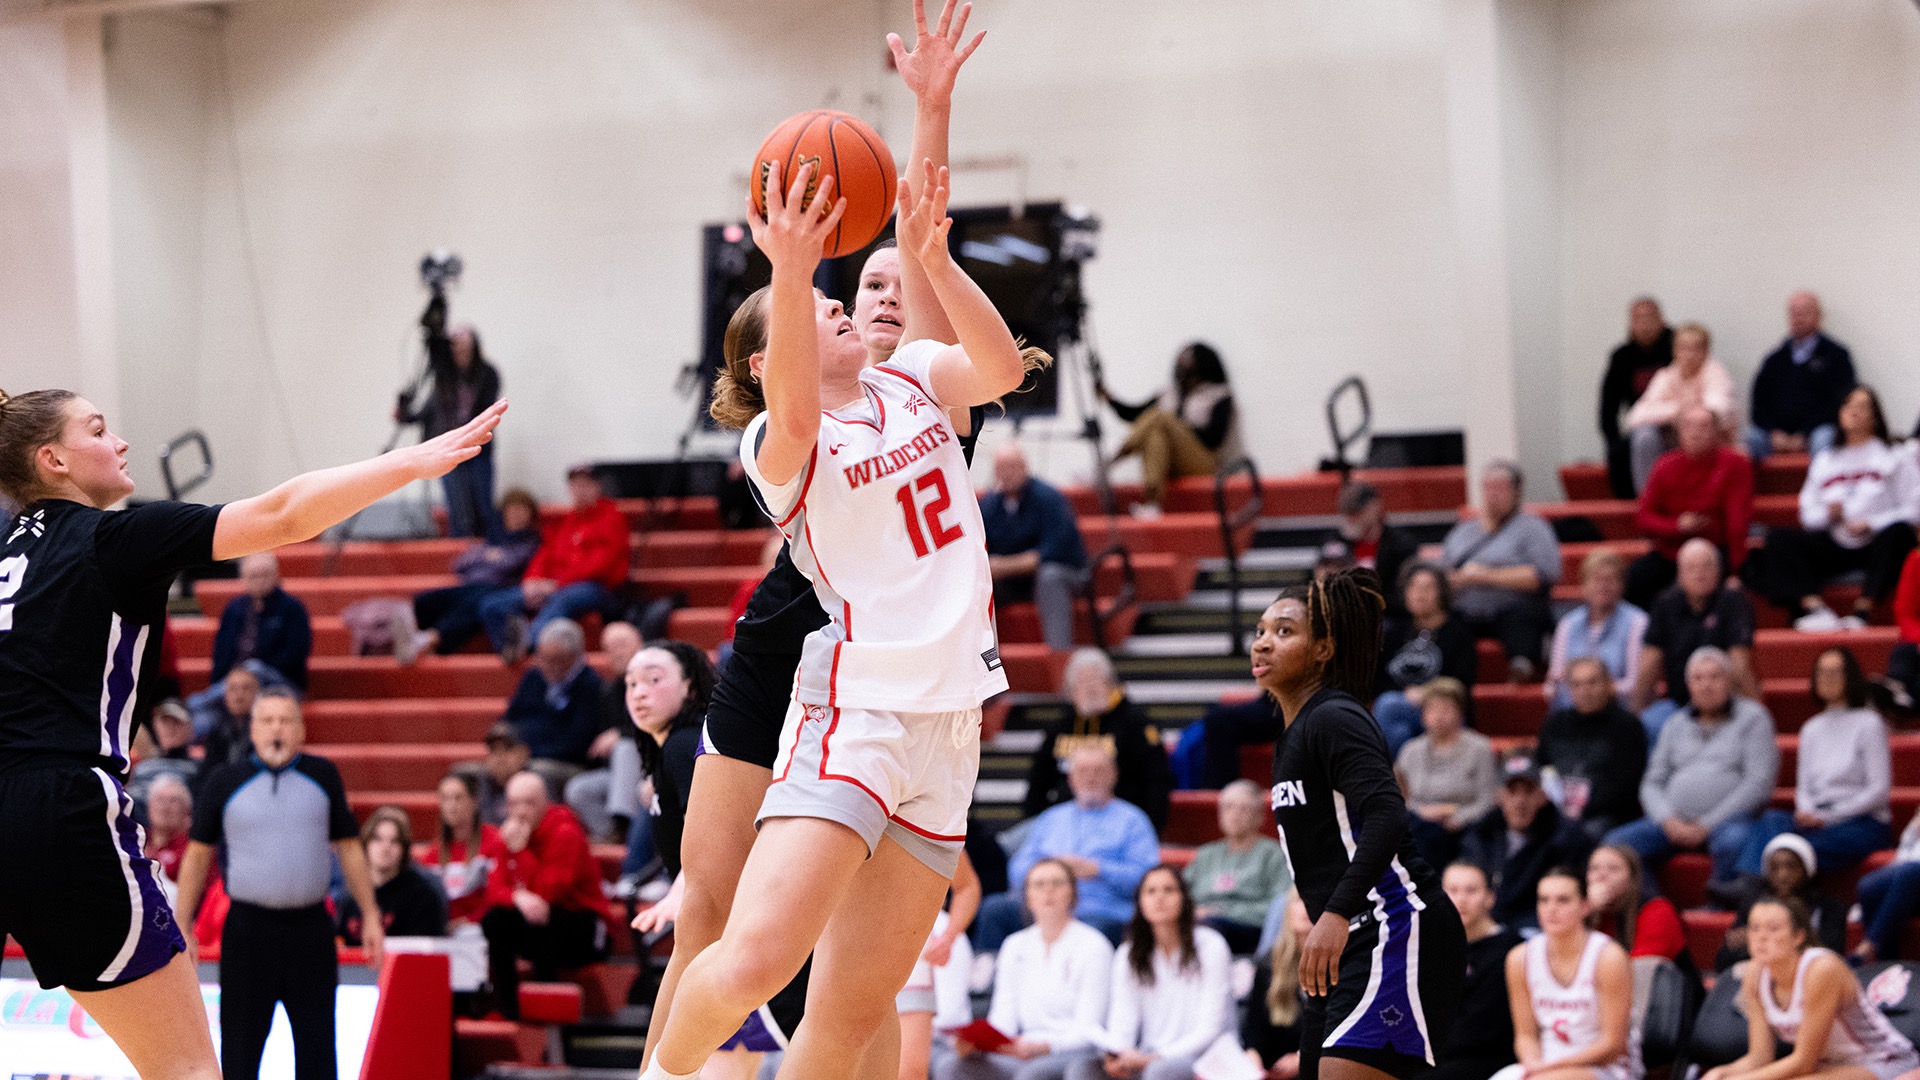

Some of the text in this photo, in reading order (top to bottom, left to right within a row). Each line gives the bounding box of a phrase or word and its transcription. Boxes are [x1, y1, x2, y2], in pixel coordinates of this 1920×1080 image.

[843, 421, 950, 490] WILDCATS
[895, 466, 966, 560] 12
[1272, 780, 1307, 811] EN
